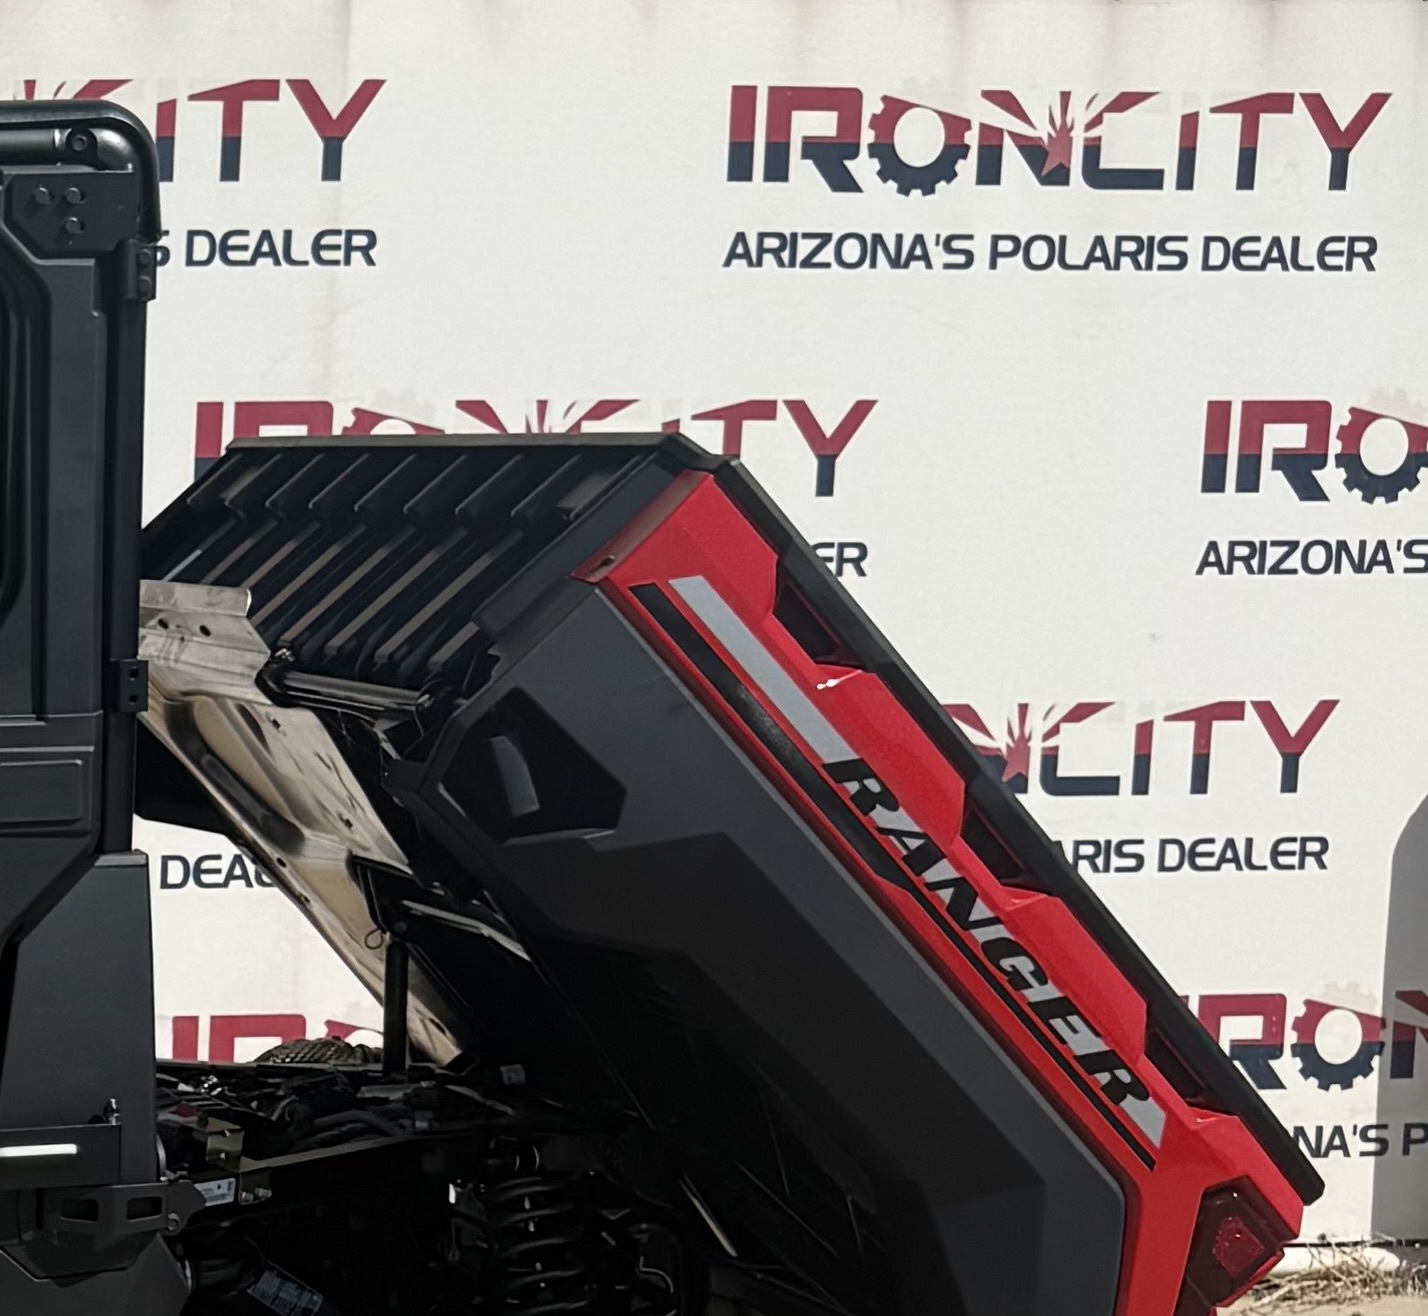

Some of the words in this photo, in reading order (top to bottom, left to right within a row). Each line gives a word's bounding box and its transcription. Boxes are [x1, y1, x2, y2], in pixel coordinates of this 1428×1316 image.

[184, 228, 378, 268] DEALER
[722, 231, 976, 270] ARIZONA'S
[988, 233, 1189, 272] POLARIS
[1200, 235, 1378, 273] DEALER
[1194, 539, 1428, 576] ARIZONA'S
[1157, 836, 1330, 873] DEALER
[822, 758, 1151, 1106] RANGER
